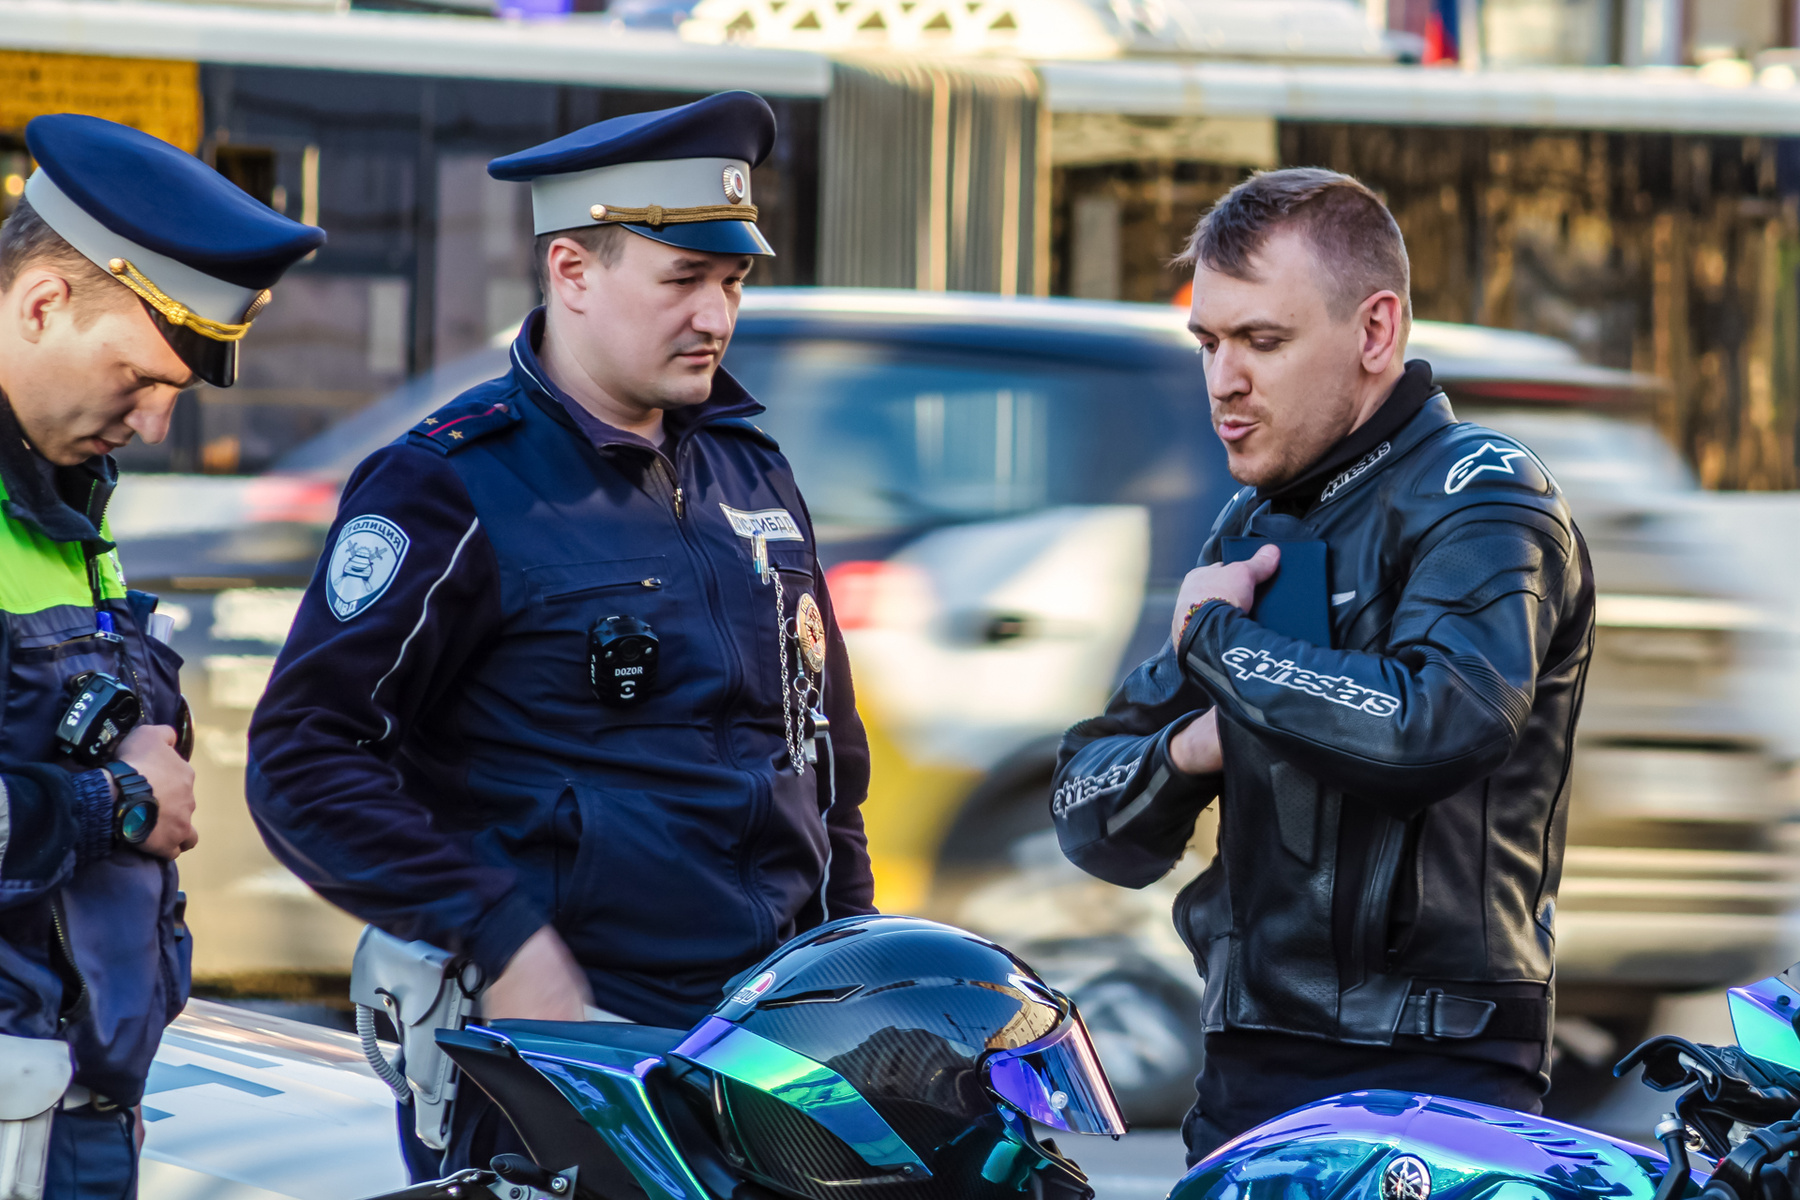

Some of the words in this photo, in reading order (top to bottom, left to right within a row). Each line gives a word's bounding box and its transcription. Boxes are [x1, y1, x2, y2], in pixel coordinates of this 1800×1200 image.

[750, 515, 797, 534] ГИБДД
[343, 521, 402, 550] ПОЛИЦИЯ
[334, 596, 358, 616] МВД
[614, 666, 643, 677] DOZOR
[1222, 647, 1400, 717] alpinestars
